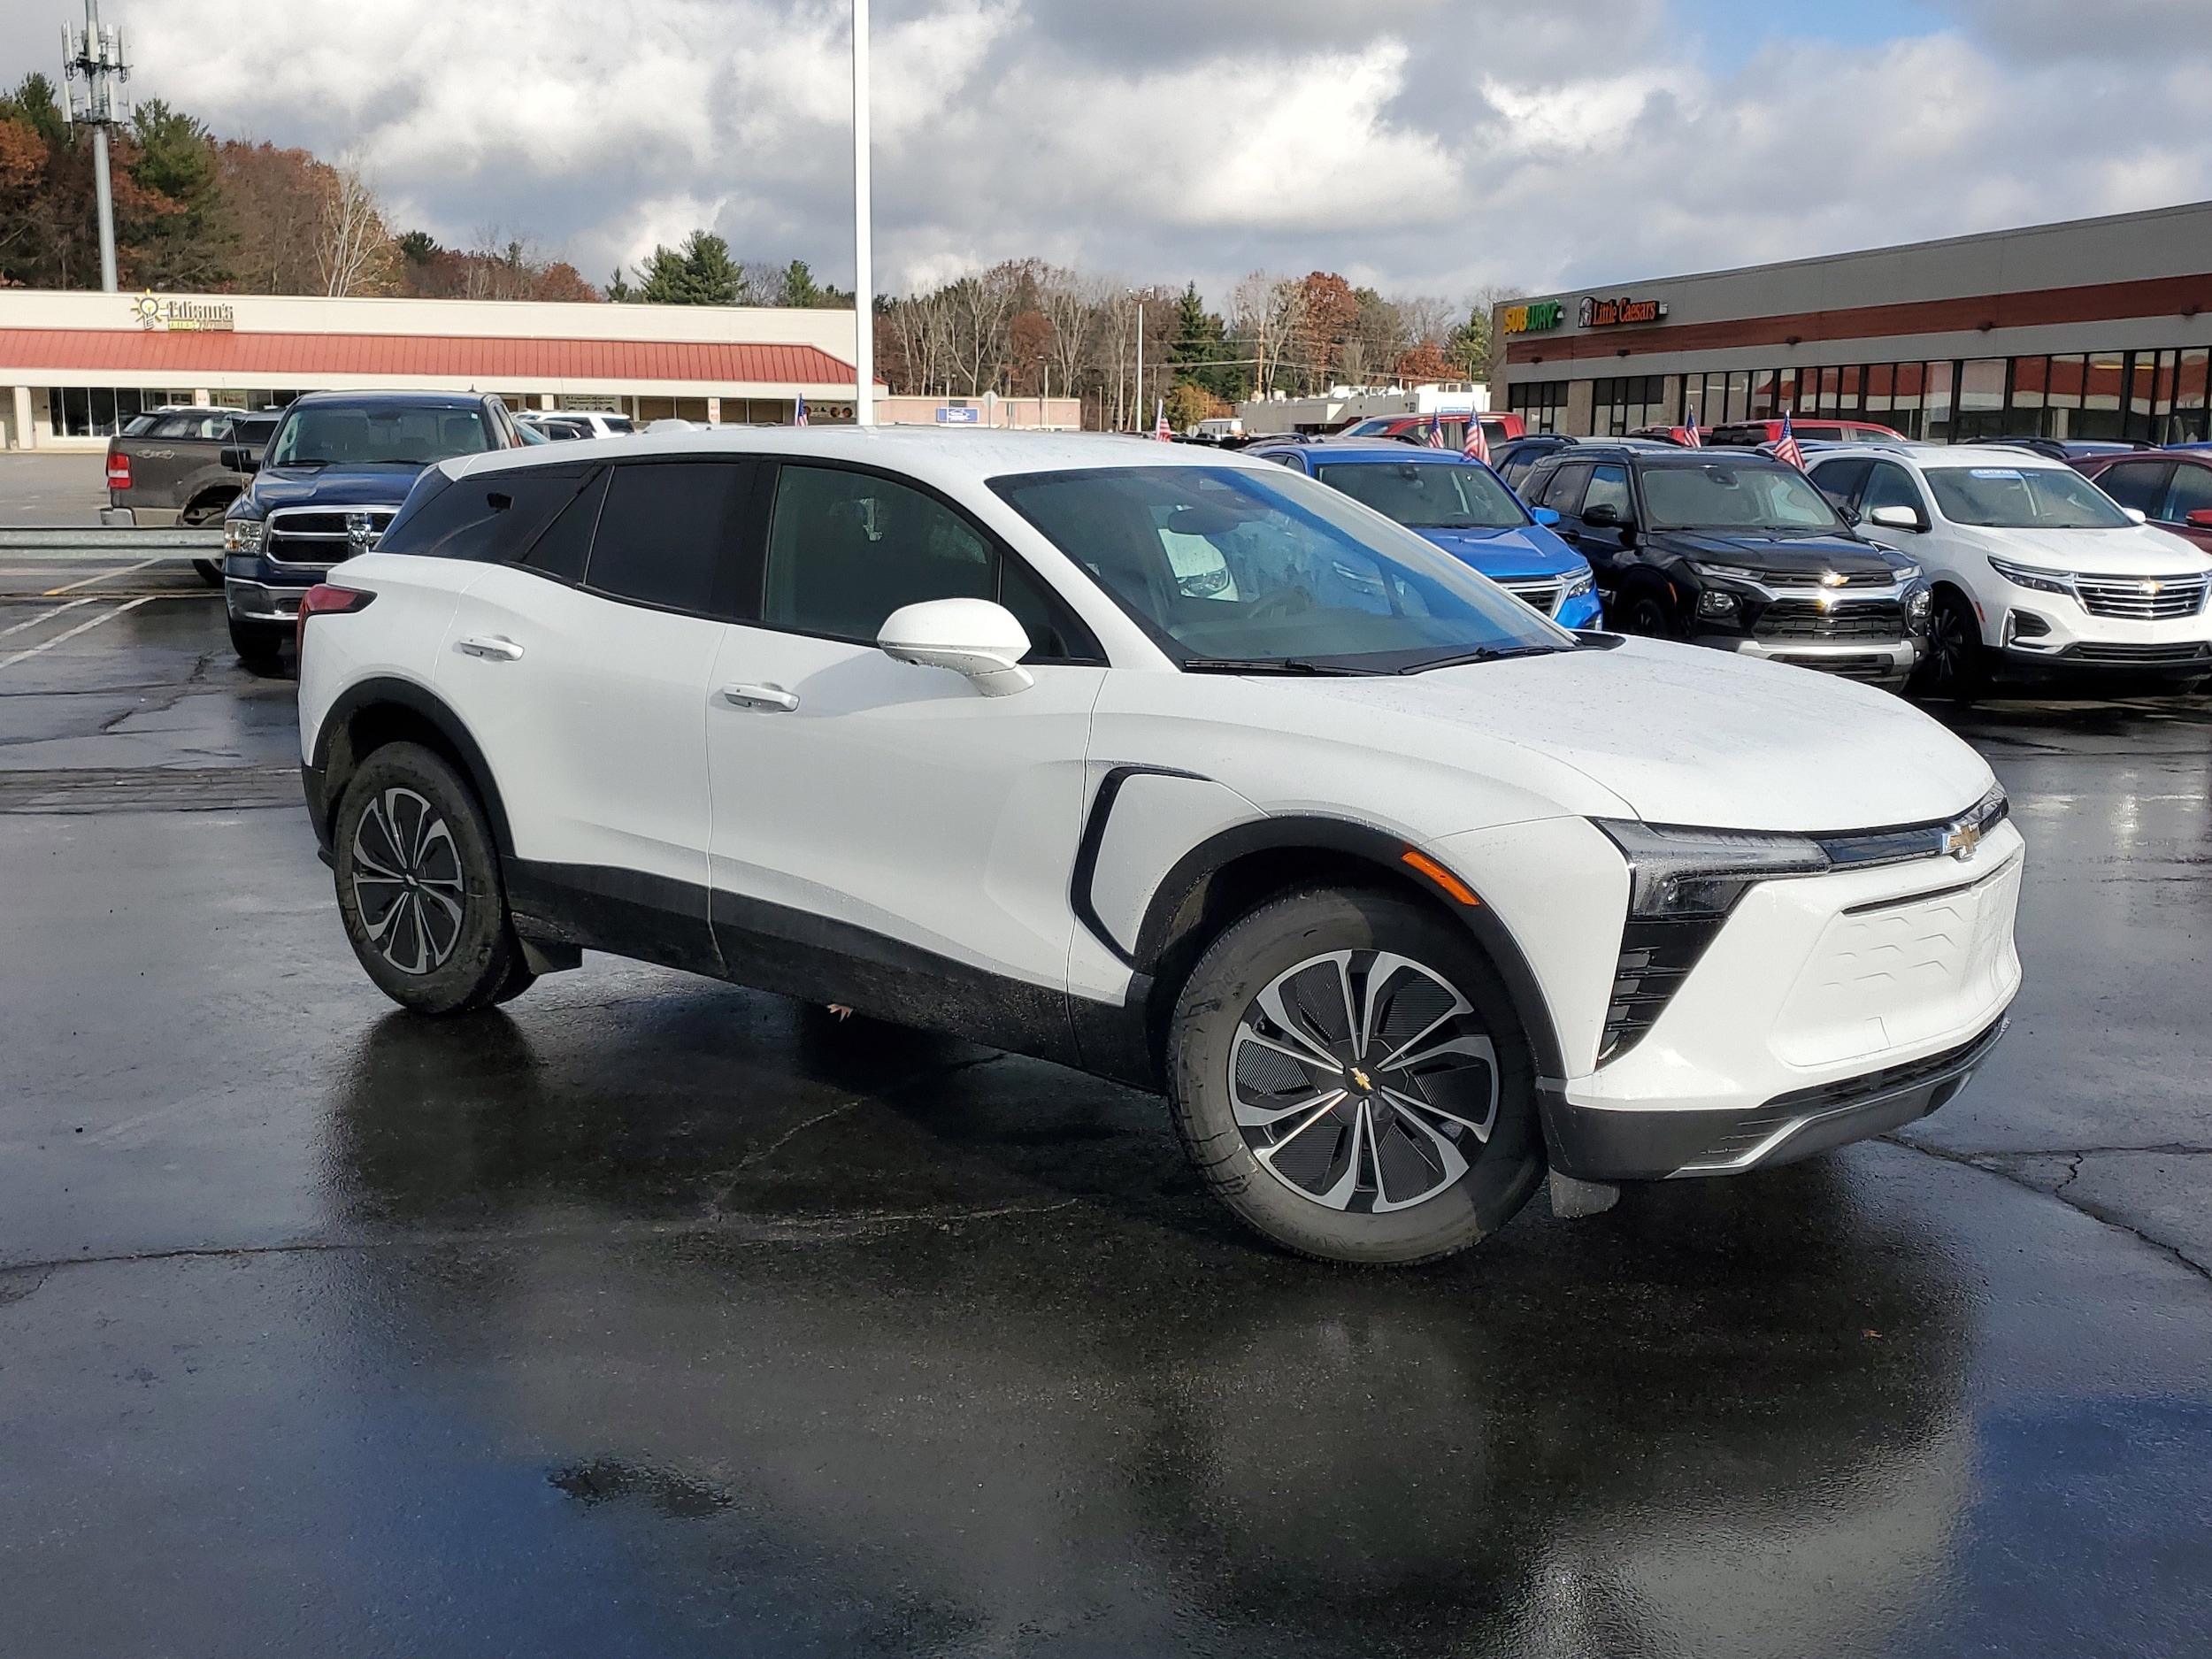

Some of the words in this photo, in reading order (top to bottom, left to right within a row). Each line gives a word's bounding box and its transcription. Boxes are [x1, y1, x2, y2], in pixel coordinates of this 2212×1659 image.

[168, 301, 233, 319] Edison's
[1503, 300, 1560, 333] SUBWAY
[1593, 303, 1617, 326] Little
[1618, 297, 1656, 323] Caesars
